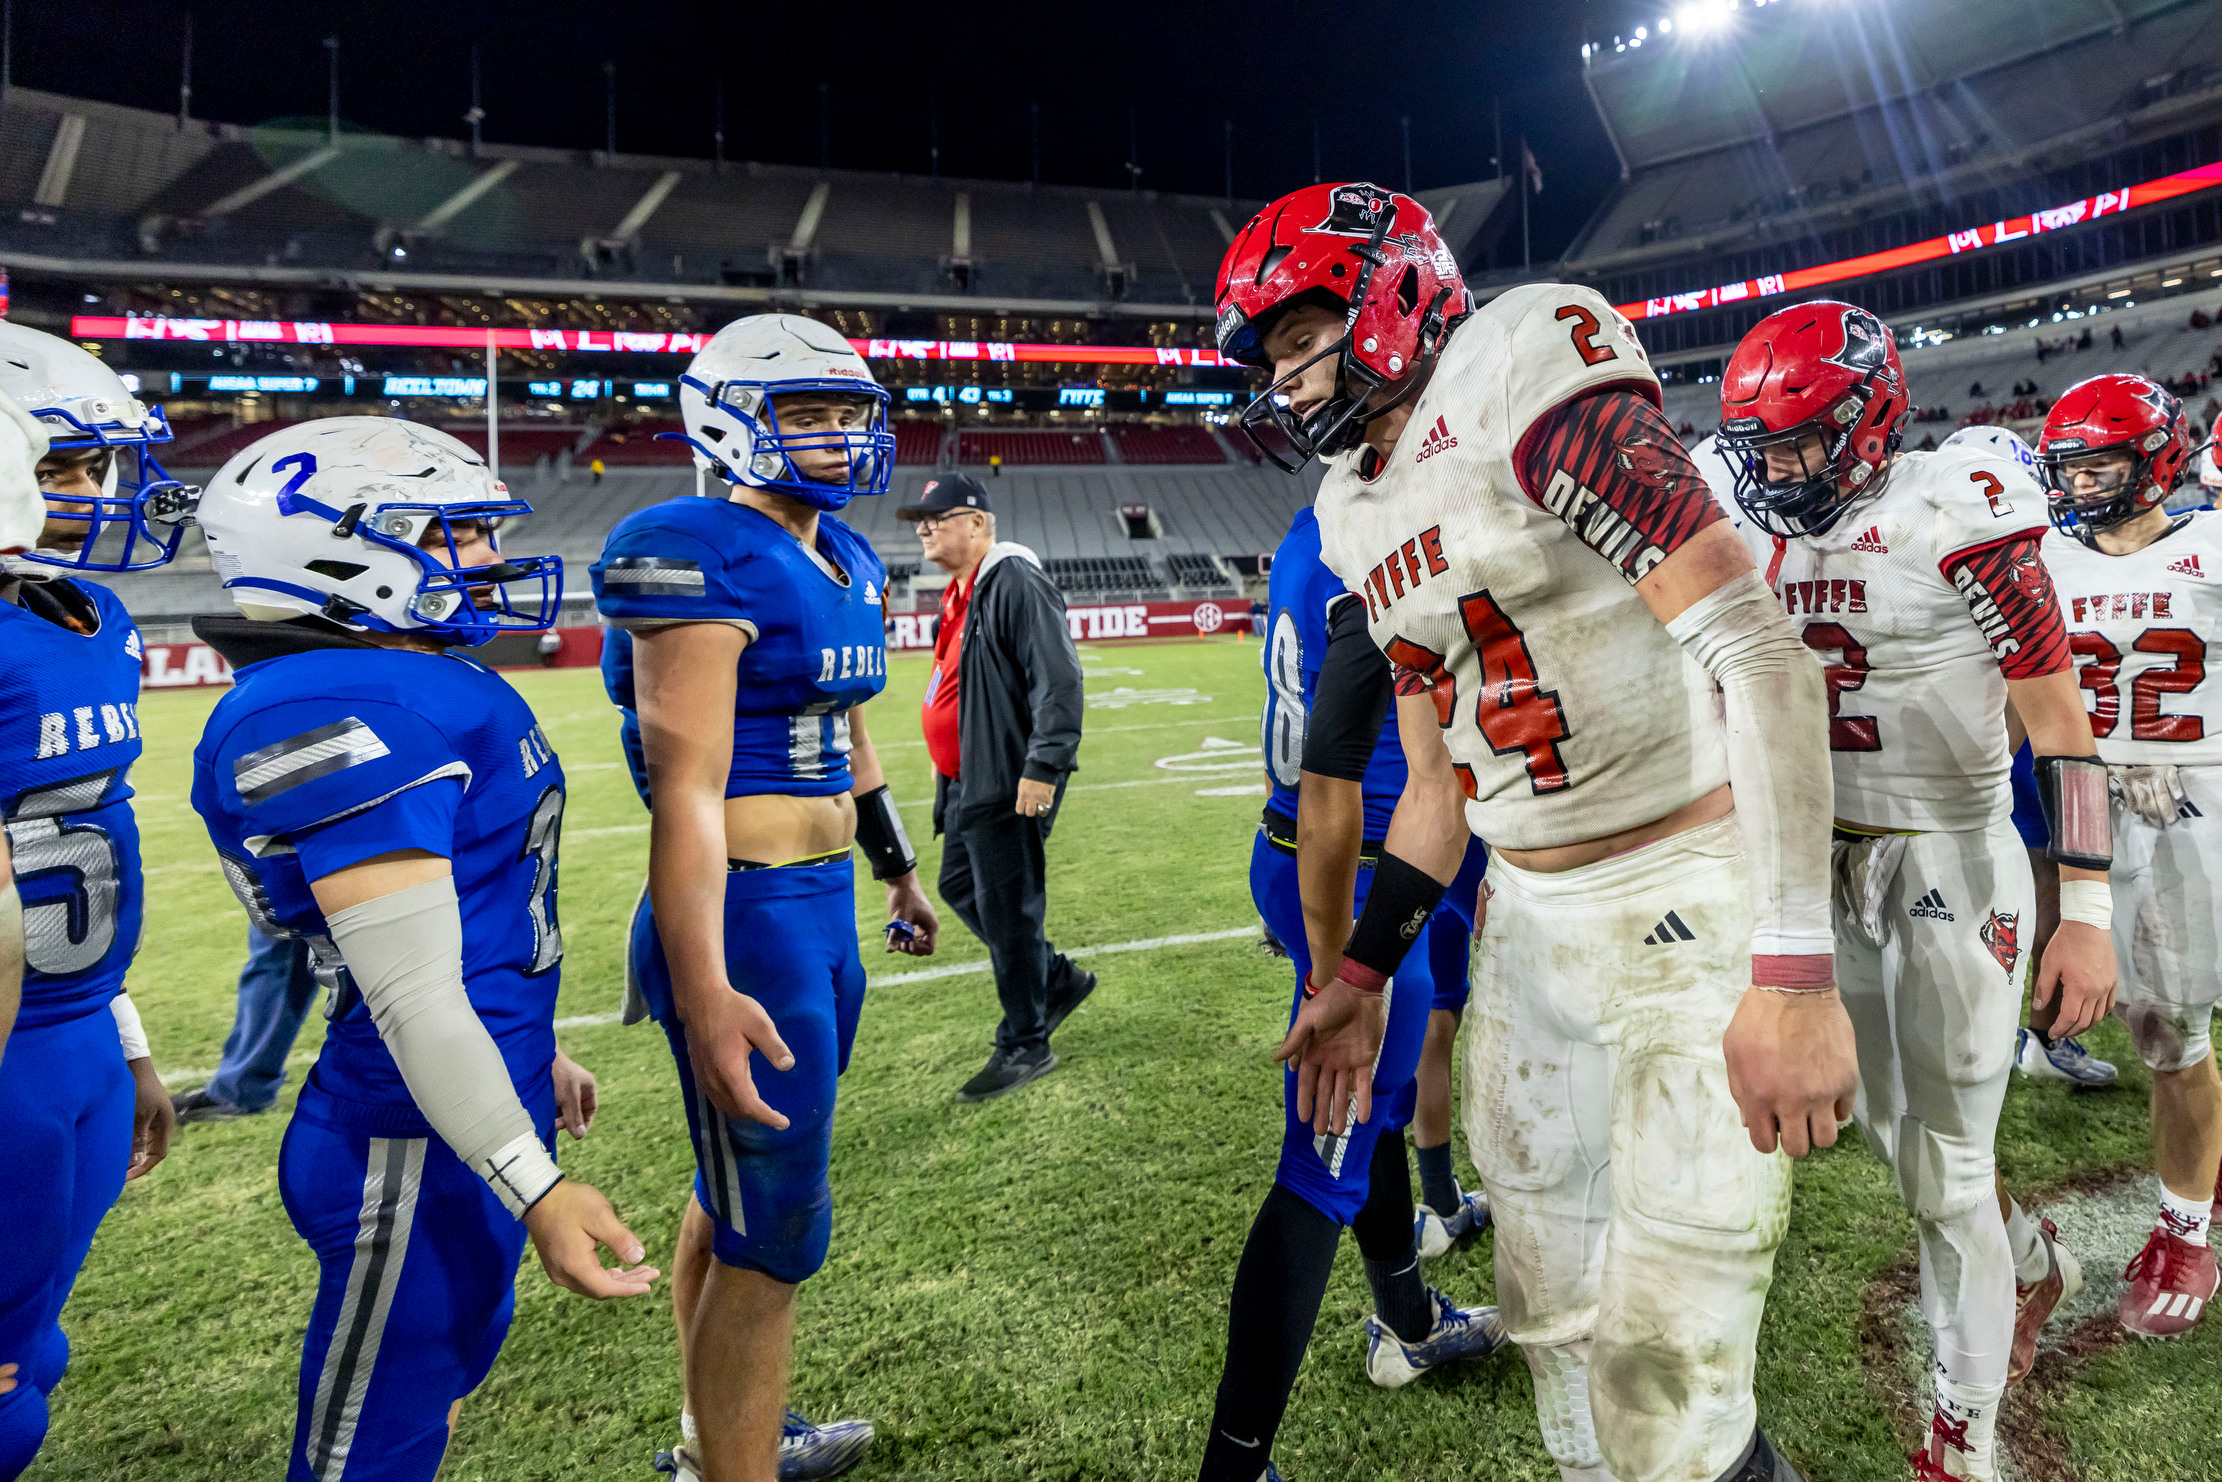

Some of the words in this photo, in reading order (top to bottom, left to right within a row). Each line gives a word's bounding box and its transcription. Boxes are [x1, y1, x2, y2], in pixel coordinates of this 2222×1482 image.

[1416, 434, 1458, 463] adidas
[1970, 470, 2015, 518] 2
[1542, 468, 1670, 586] DEVILS
[1850, 541, 1889, 554] adidas
[1363, 524, 1449, 624] FYFFE
[2167, 563, 2205, 578] adidas
[1784, 579, 1868, 615] FYFFE
[1954, 564, 2021, 660] DEVILS
[2072, 592, 2173, 623] FYFFE
[2068, 628, 2207, 743] 32
[1909, 906, 1955, 922] adidas
